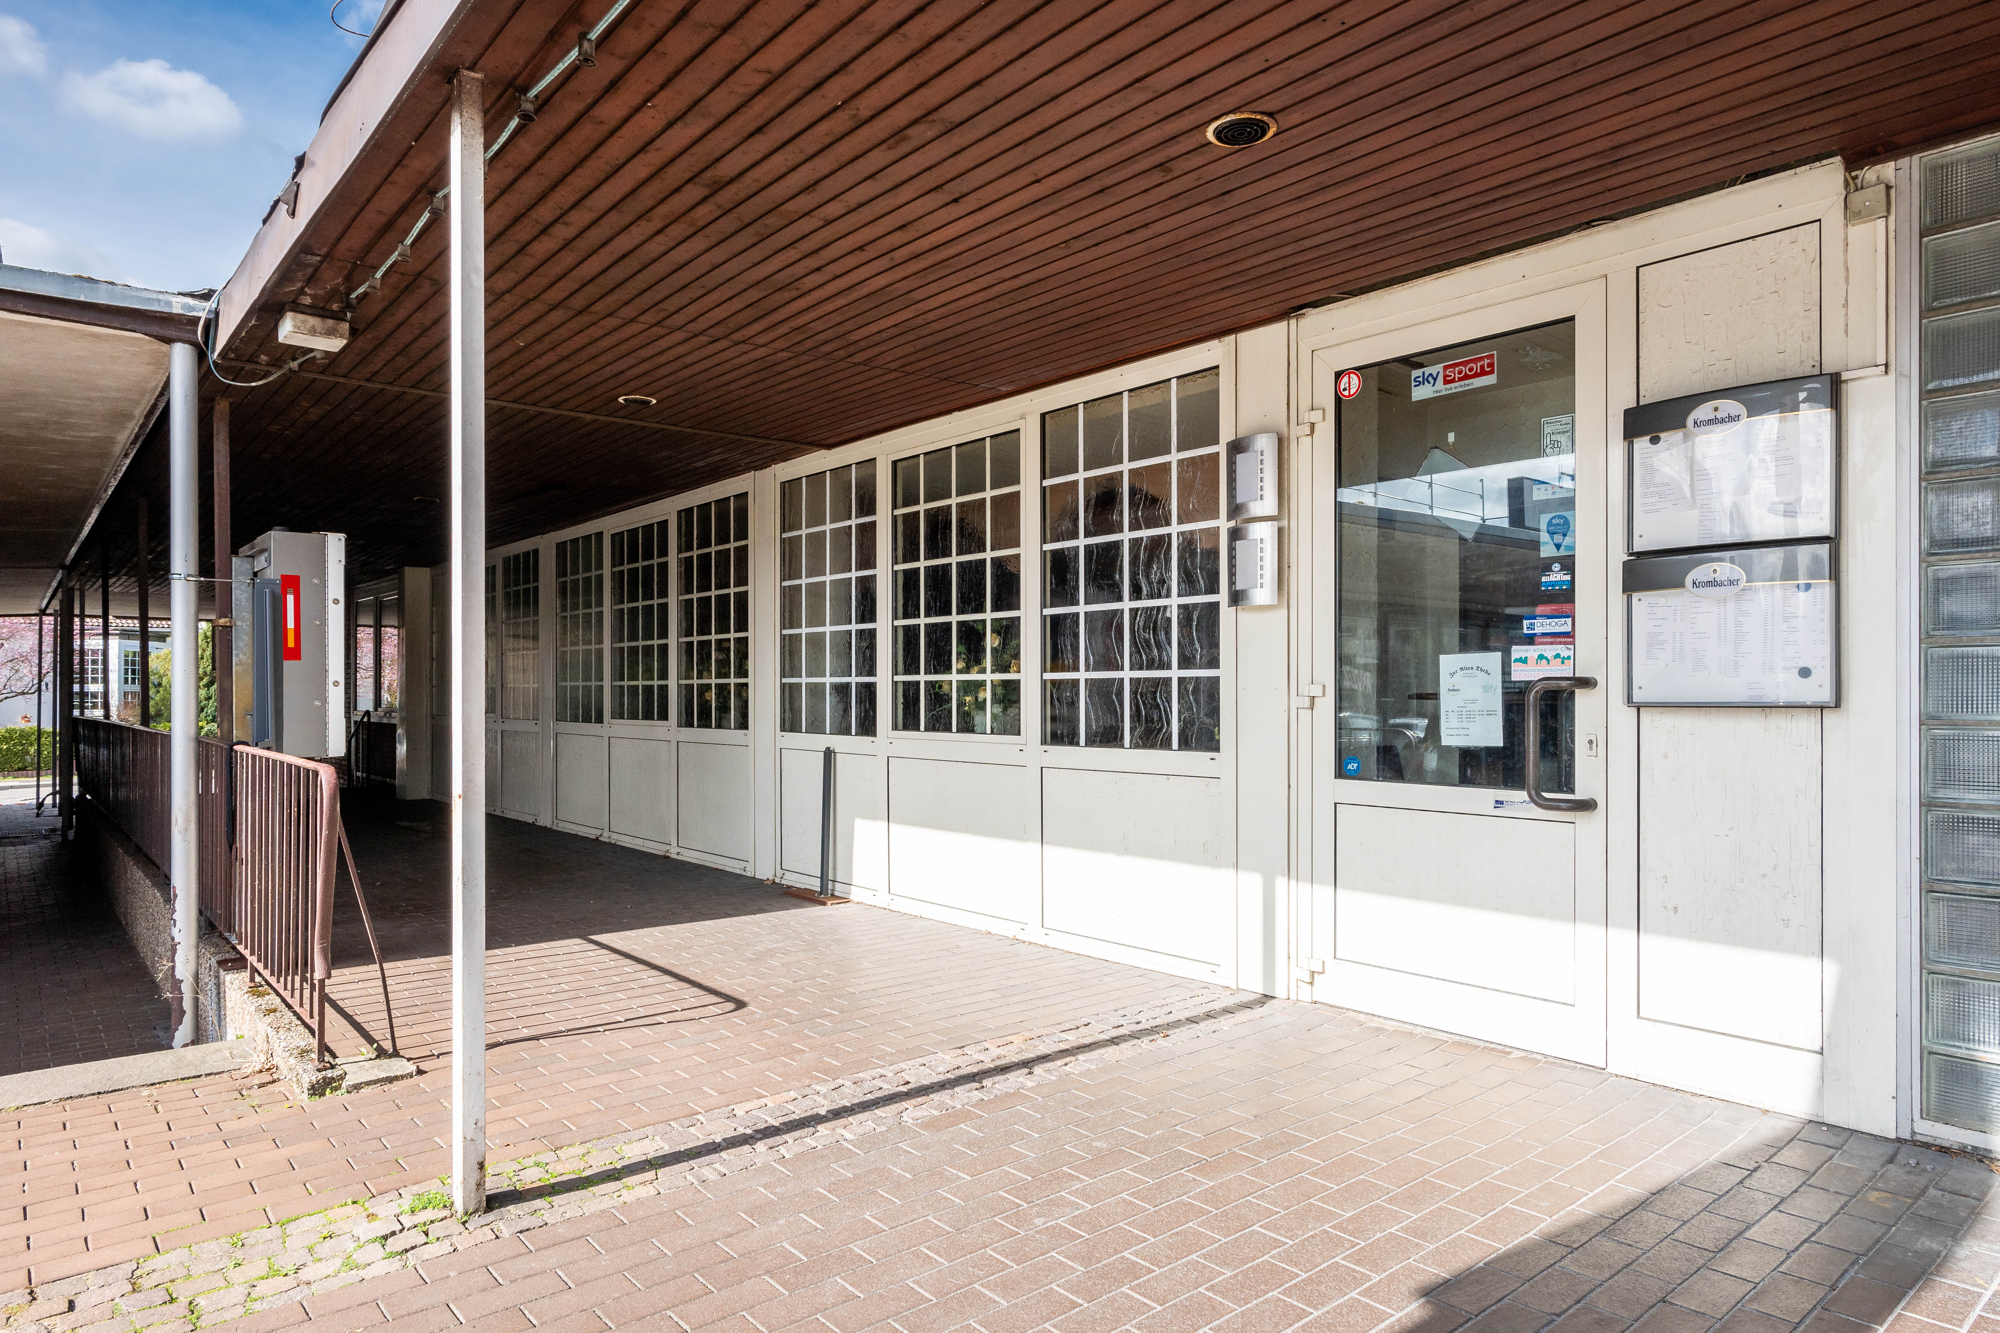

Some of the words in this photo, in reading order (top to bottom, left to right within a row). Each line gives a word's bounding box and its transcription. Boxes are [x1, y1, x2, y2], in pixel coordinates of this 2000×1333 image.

[1413, 371, 1440, 387] sky
[1446, 358, 1491, 381] sport
[1433, 387, 1444, 395] Hier
[1454, 381, 1474, 390] erleben
[1693, 413, 1741, 428] Krombacher
[1552, 517, 1564, 525] sky
[1692, 576, 1740, 589] Krombacher
[1536, 620, 1569, 628] DEHOGA
[1482, 681, 1498, 696] sky
